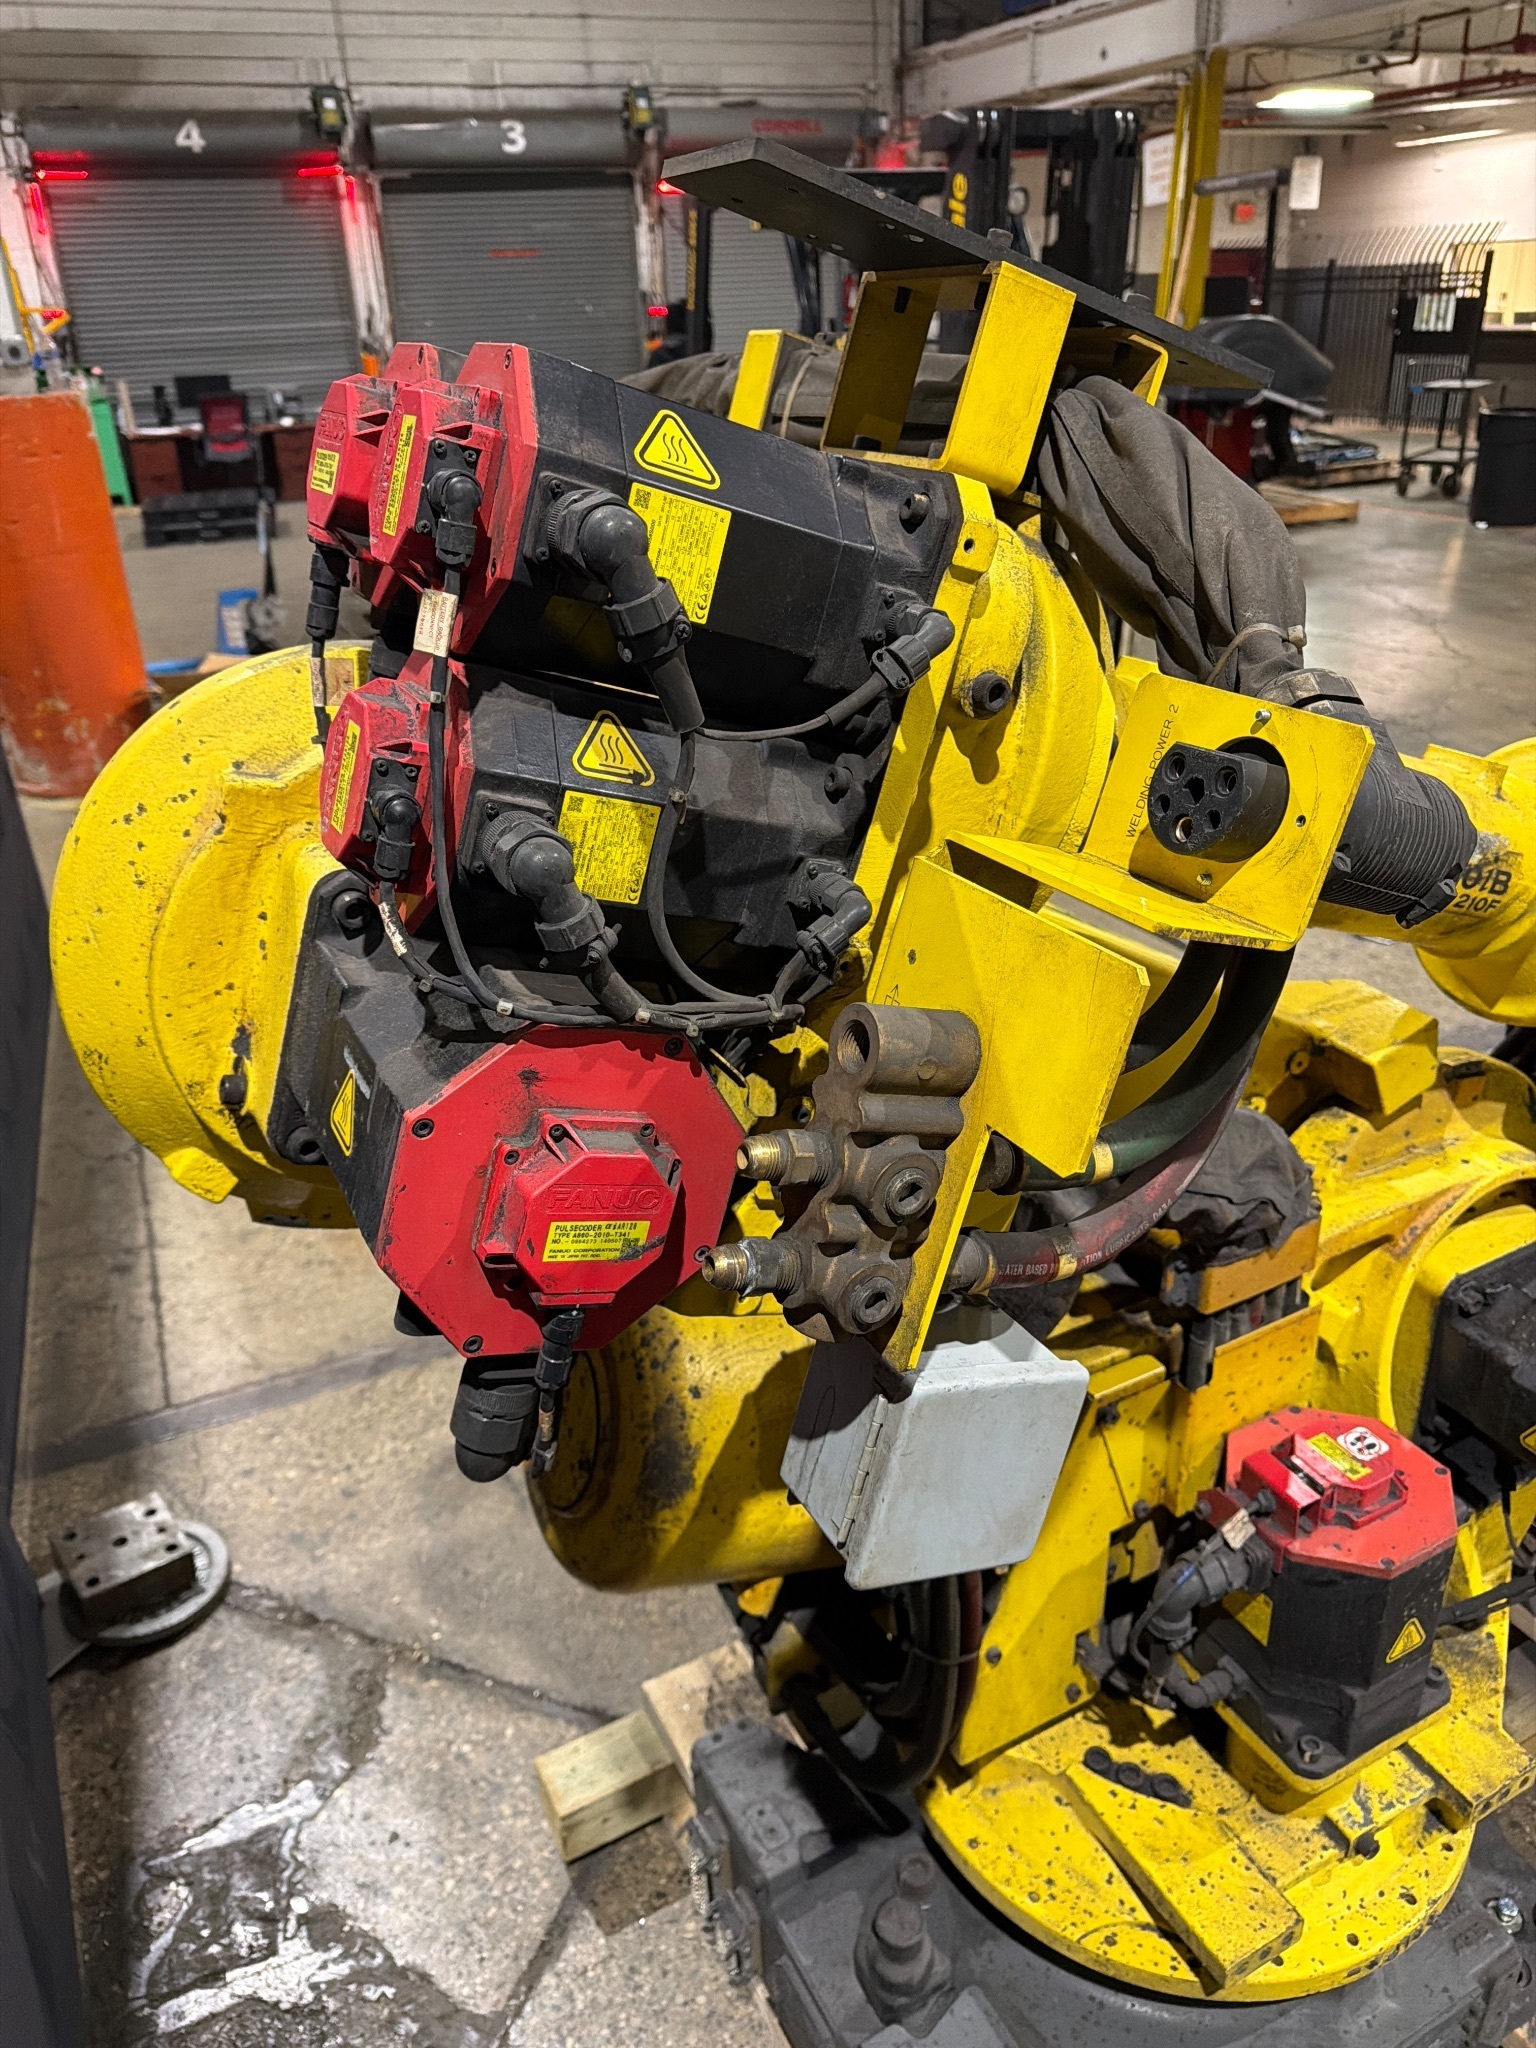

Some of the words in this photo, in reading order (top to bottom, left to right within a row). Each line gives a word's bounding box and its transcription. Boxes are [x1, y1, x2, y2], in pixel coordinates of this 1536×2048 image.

[175, 119, 206, 154] 4
[500, 119, 528, 155] 3
[1126, 776, 1153, 838] WELDING
[1150, 719, 1174, 770] POWER
[1169, 704, 1179, 714] 2
[548, 1187, 661, 1210] FANUC
[555, 1224, 603, 1232] PULSECODER
[1025, 1263, 1048, 1275] BASED
